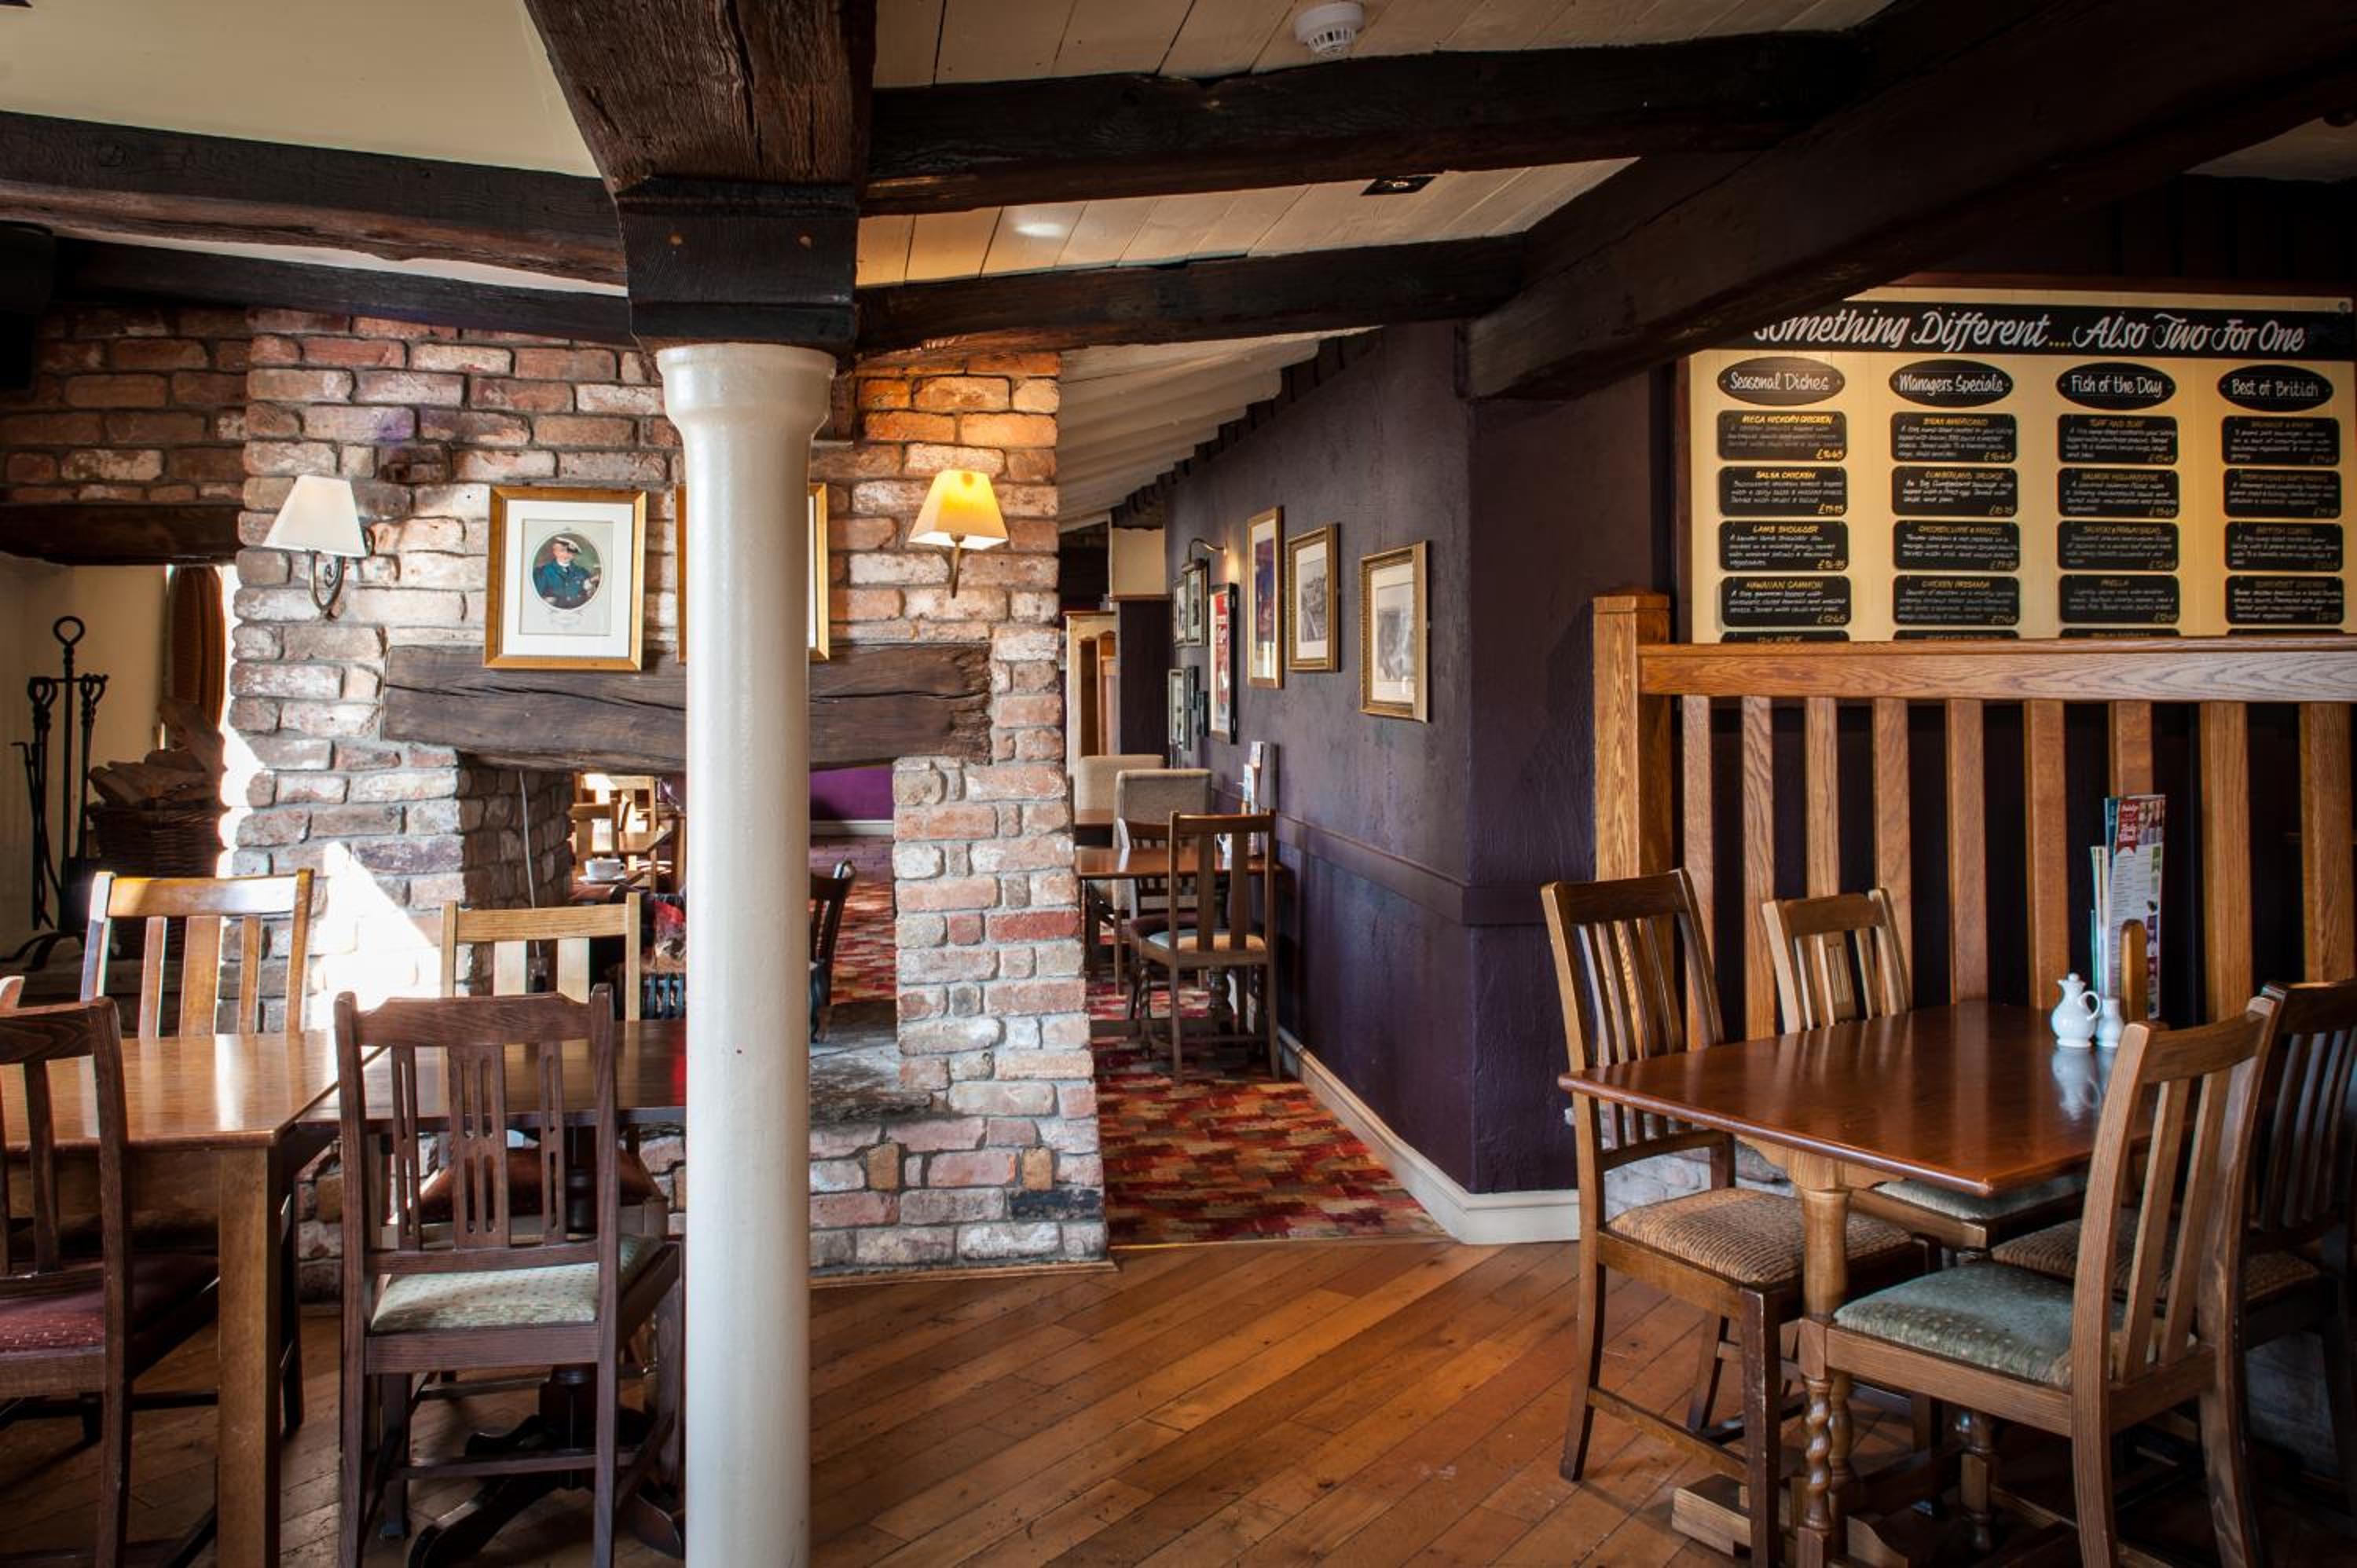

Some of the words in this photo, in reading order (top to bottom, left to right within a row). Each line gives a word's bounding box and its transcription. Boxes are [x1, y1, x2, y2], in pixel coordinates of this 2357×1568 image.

[2072, 313, 2150, 350] Also
[2152, 313, 2211, 350] Two
[2211, 319, 2257, 352] For
[2258, 321, 2306, 354] One
[1730, 372, 1780, 390] Seasonal
[1784, 372, 1829, 390] Dishes
[1899, 374, 1952, 397] Managers
[1956, 375, 2003, 395] Specials
[2072, 375, 2096, 393] Fish
[2099, 376, 2110, 393] of
[2113, 376, 2135, 394] the
[2137, 376, 2163, 399] Day
[2231, 379, 2256, 395] Best
[2259, 379, 2273, 397] of
[2276, 380, 2318, 397] British
